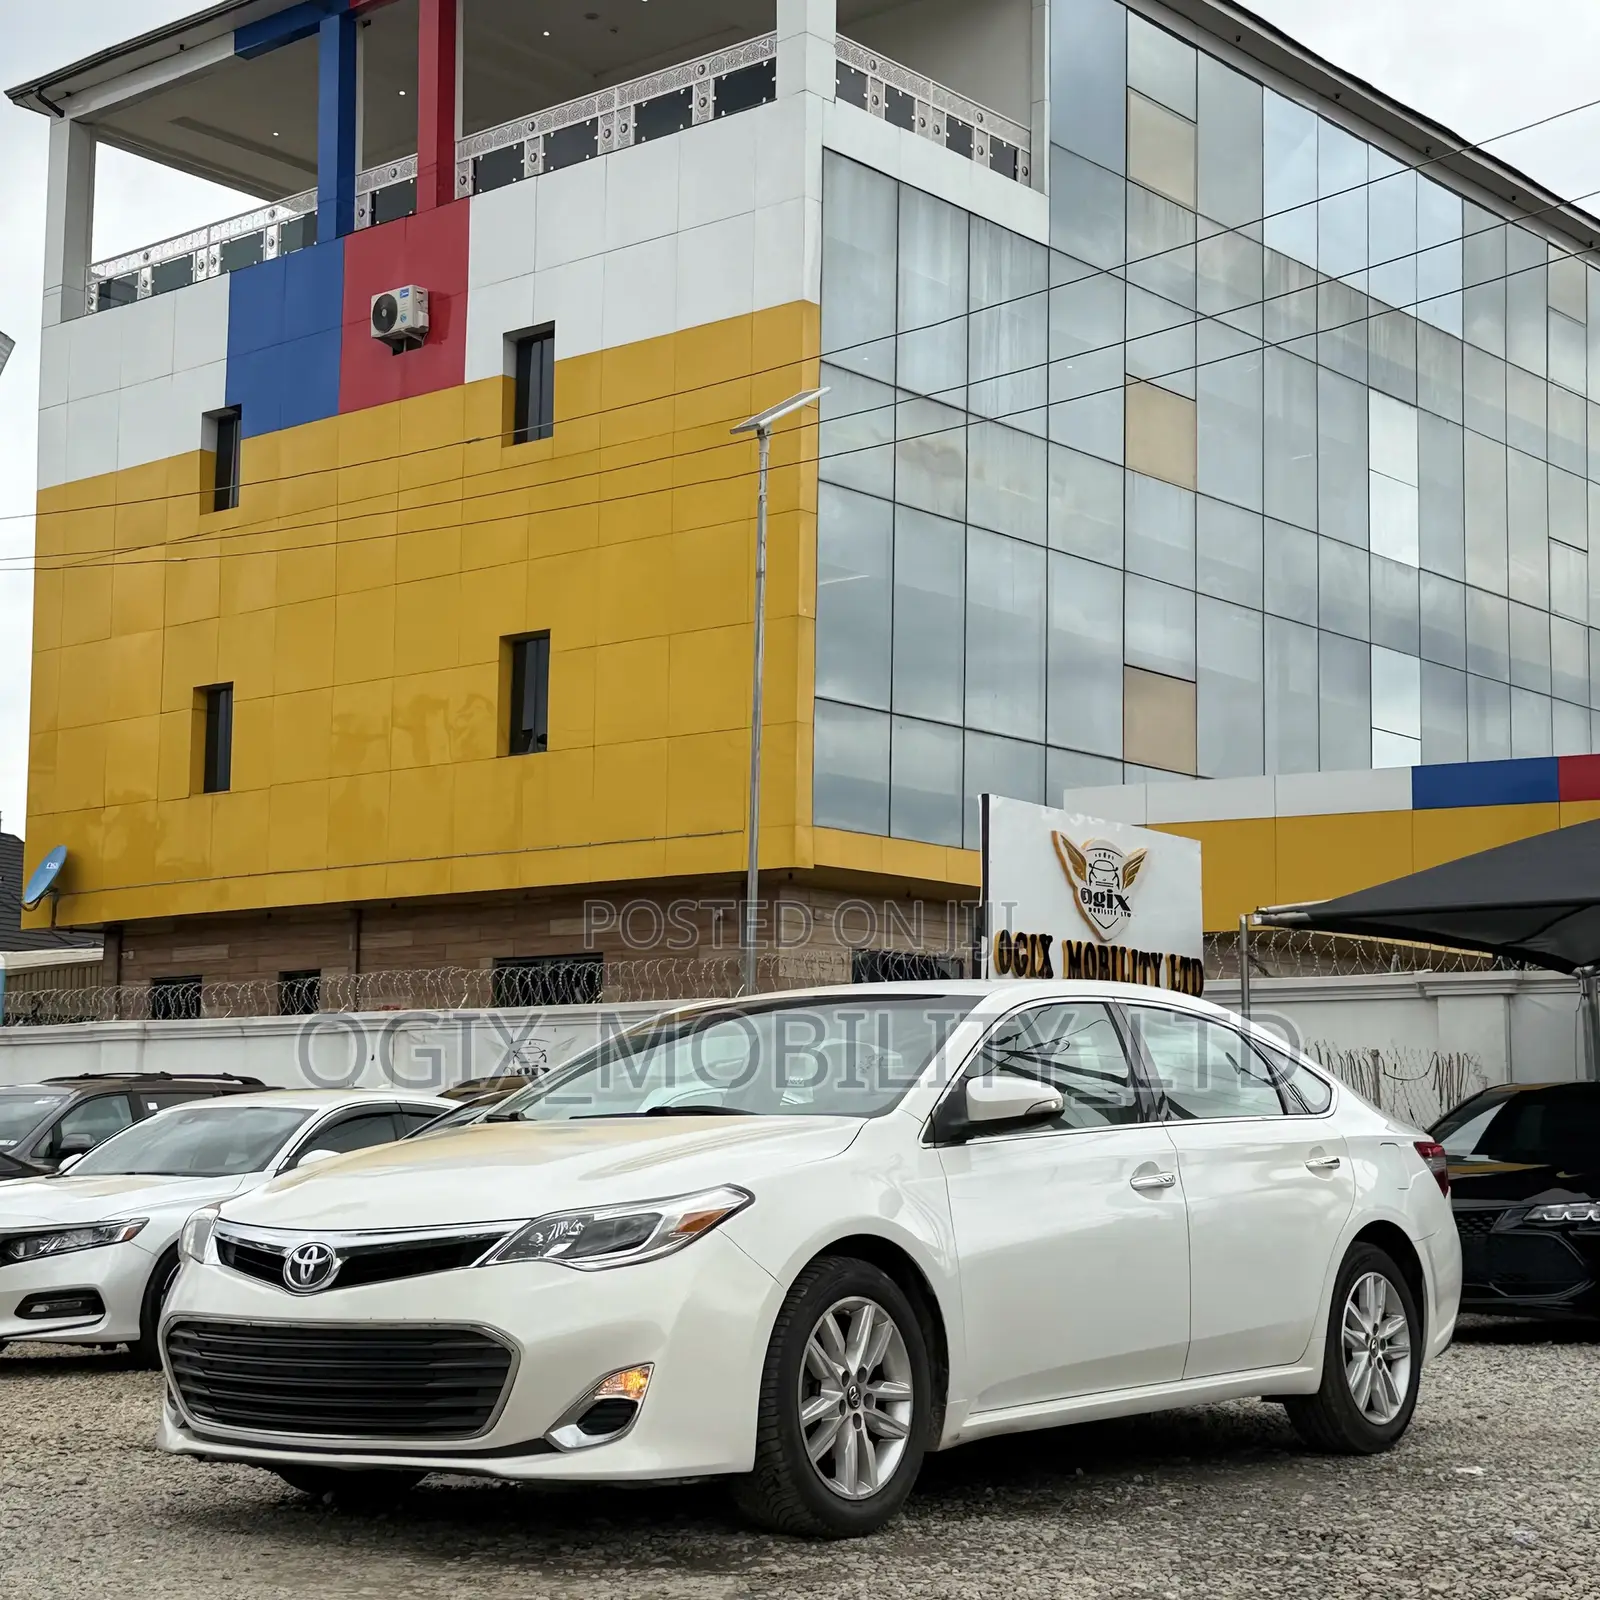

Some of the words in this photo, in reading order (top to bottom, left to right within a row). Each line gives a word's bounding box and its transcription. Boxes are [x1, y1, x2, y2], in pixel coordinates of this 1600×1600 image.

[994, 930, 1054, 979] OGIX
[1062, 940, 1163, 988] MOBILITY
[1165, 954, 1204, 998] LTD
